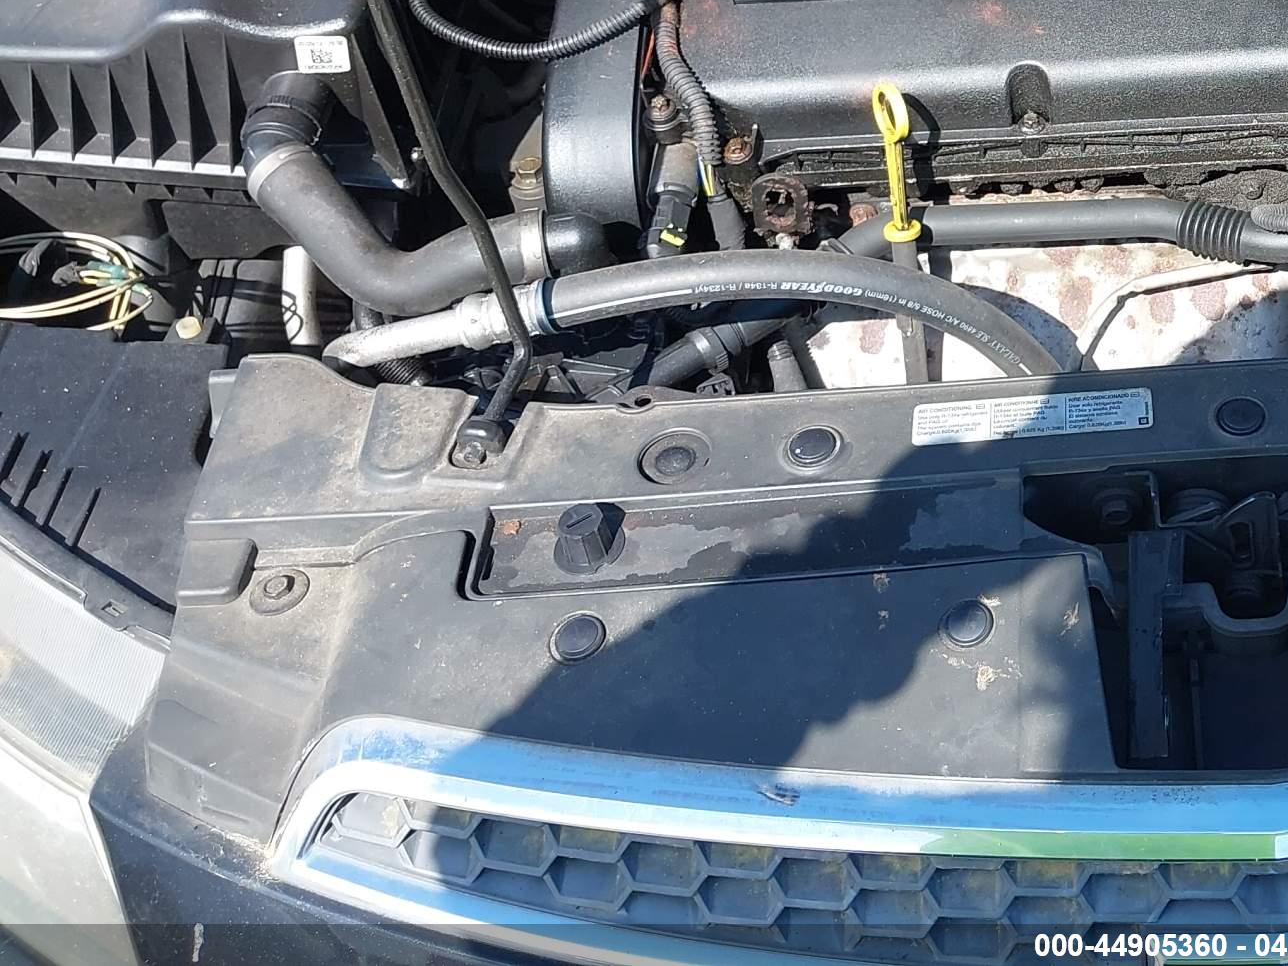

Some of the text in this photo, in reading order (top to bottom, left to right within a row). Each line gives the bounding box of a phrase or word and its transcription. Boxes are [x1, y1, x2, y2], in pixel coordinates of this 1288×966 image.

[781, 281, 863, 297] GOODYEAR
[919, 305, 946, 320] HOSE
[944, 314, 961, 326] A/C
[975, 330, 991, 342] SLE
[990, 339, 1021, 365] GALAXY
